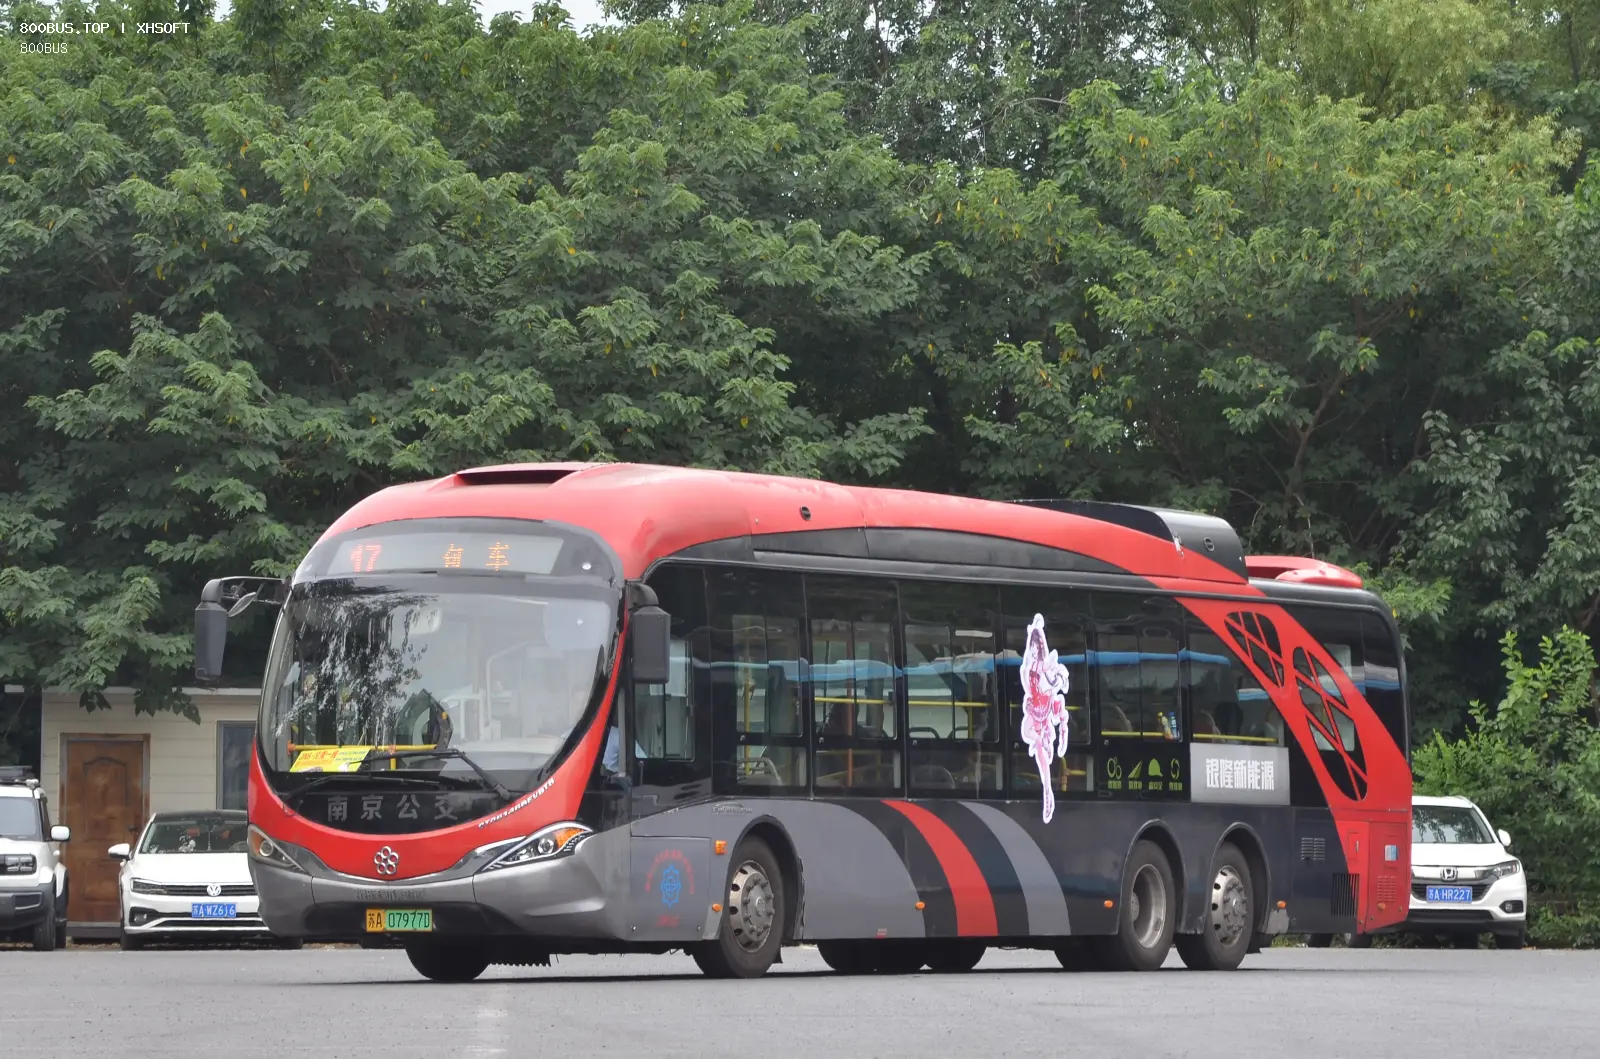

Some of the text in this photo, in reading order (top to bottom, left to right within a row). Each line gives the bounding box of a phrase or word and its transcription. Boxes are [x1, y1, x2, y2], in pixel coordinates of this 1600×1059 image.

[1205, 758, 1275, 791] 银隆新能源
[327, 793, 458, 822] 南京公交
